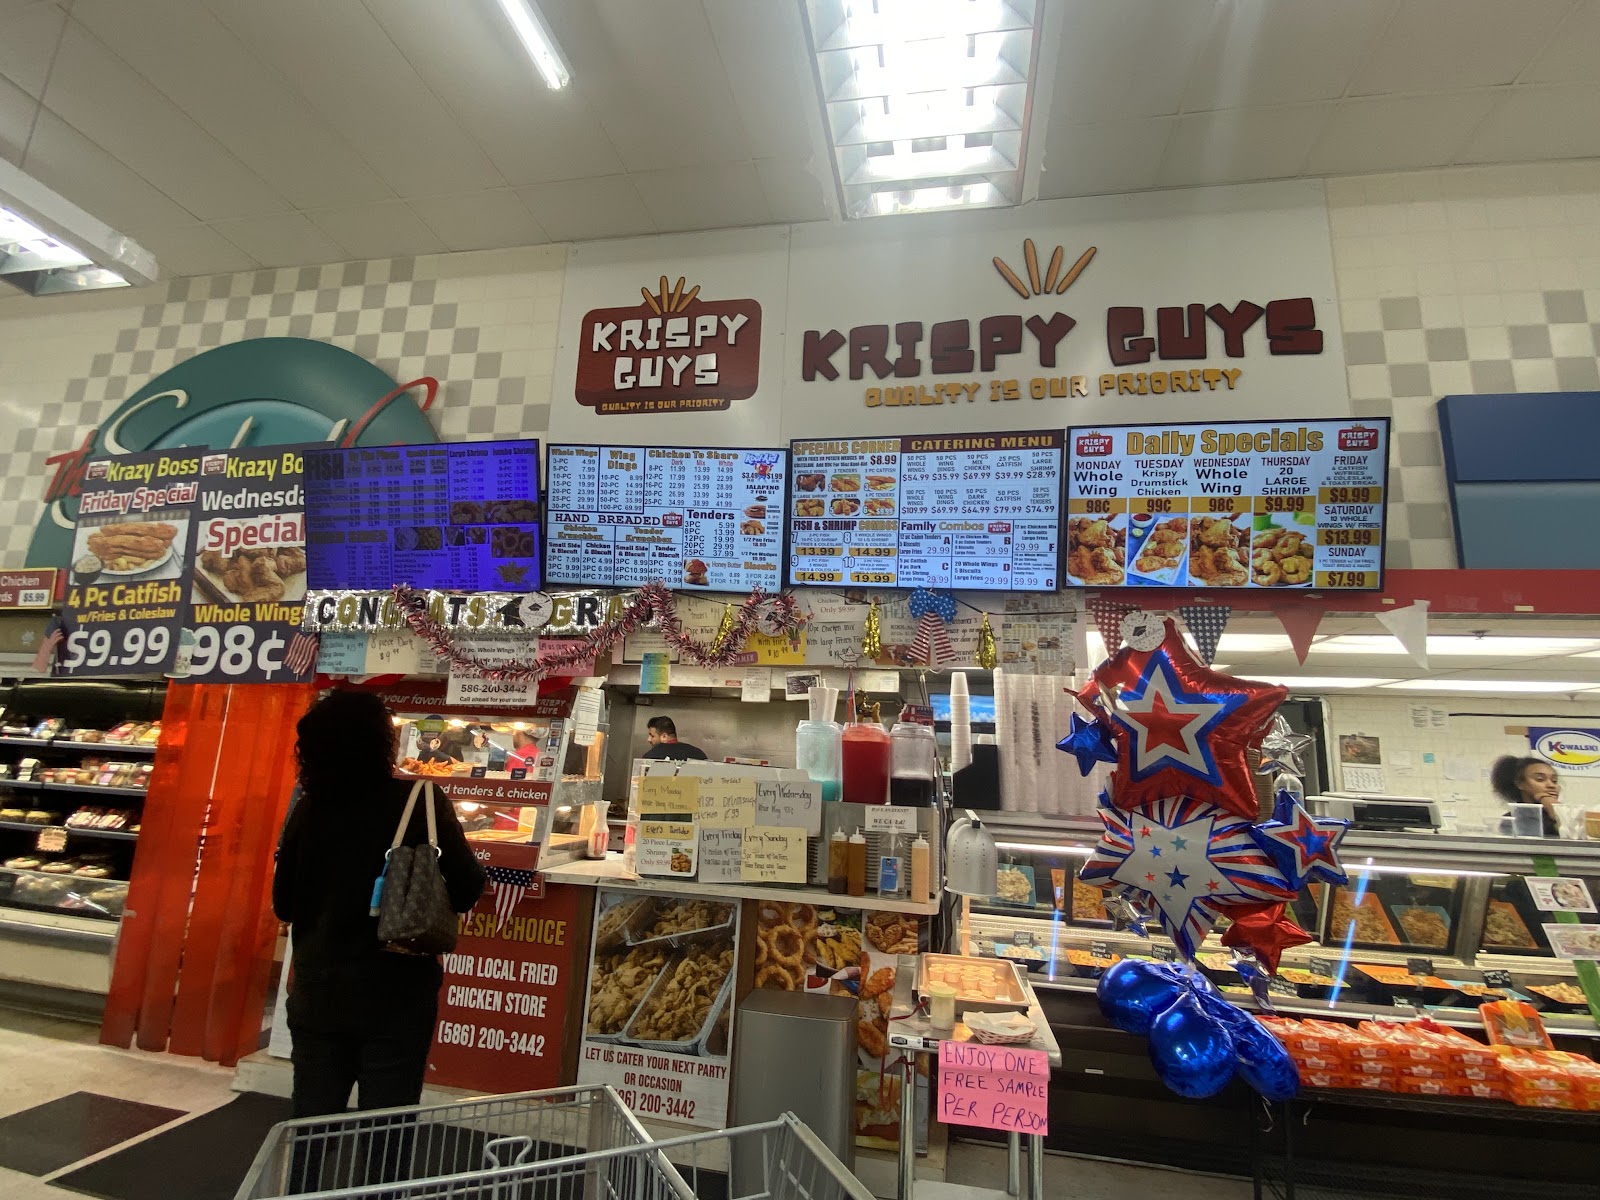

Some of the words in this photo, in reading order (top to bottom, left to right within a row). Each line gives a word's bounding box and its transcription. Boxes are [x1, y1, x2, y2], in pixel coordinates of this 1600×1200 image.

[593, 313, 748, 352] KRISPY
[802, 311, 1077, 382] KRISPY
[1107, 297, 1324, 366] GUYS
[614, 353, 718, 390] GUYS
[864, 381, 981, 408] QUALITY
[990, 378, 1021, 402] IS
[1030, 374, 1089, 399] OUR
[1099, 367, 1243, 396] PRIORITY
[602, 401, 641, 411] QUALITY
[644, 400, 655, 410] IS
[657, 400, 677, 409] OUR
[679, 398, 725, 408] PRIORITY
[793, 442, 848, 455] SPECIALS
[851, 440, 900, 453] CORNER
[911, 438, 996, 450] CATERING
[1001, 436, 1053, 448] MENU
[1079, 438, 1110, 446] KRISPY
[1127, 431, 1195, 456] Daily
[1201, 427, 1323, 456] Specials
[649, 450, 691, 458] Chicken
[692, 451, 705, 459] To
[706, 451, 739, 460] Share
[870, 455, 897, 465] $8.99
[1261, 457, 1310, 466] THURSDAY
[1334, 456, 1368, 465] FRIDAY
[226, 457, 277, 481] Krazy
[281, 453, 304, 475] Bo
[1076, 461, 1121, 470] MONDAY
[1135, 459, 1184, 468] TUESDAY
[1194, 458, 1250, 467] WEDNESDAY
[107, 462, 154, 483] Krazy
[157, 457, 199, 477] Boss
[932, 473, 960, 481] $35.99
[963, 472, 991, 480] $69.99
[995, 471, 1024, 480] $39.99
[1026, 471, 1056, 479] $28.99
[1074, 471, 1123, 481] Whole
[1142, 470, 1177, 478] Krispy
[1196, 468, 1247, 479] Whole
[1279, 467, 1293, 475] 20
[902, 474, 930, 482] $54.99
[1131, 479, 1188, 487] Drumstick
[1265, 477, 1307, 485] LARGE
[1079, 485, 1117, 497] Wing
[1137, 488, 1181, 496] Chicken
[1201, 482, 1242, 495] Wing
[1262, 487, 1310, 495] SHRIMP
[1330, 487, 1370, 503] $9.99
[79, 491, 132, 514] Friday
[133, 482, 198, 512] Special
[202, 484, 304, 511] Wednesd
[1265, 496, 1304, 512] $9.99
[1086, 499, 1110, 513] 98¢
[1146, 498, 1171, 513] 99¢
[1209, 498, 1234, 512] 98¢
[1324, 506, 1374, 514] SATURDAY
[555, 514, 590, 522] HAND
[598, 515, 661, 525] BREADED
[687, 509, 735, 520] Tenders
[793, 521, 812, 530] FISH
[814, 521, 821, 530] &
[822, 521, 857, 530] SHRIMP
[859, 521, 898, 530] COMBOS
[901, 522, 936, 532] Family
[939, 521, 984, 531] Combos
[208, 514, 305, 555] Special
[1325, 530, 1371, 545] $13.99
[1329, 548, 1366, 557] SUNDAY
[1, 575, 40, 587] Chicken
[1328, 571, 1365, 587] $7.99
[23, 592, 45, 602] $5.99
[68, 589, 80, 608] 4
[84, 588, 108, 608] Pc
[112, 580, 182, 606] Catfish
[76, 610, 115, 623] w/Fries
[118, 609, 126, 621] &
[129, 607, 176, 621] Coleslaw
[195, 603, 250, 623] Whole
[550, 597, 653, 626] GRA
[63, 624, 170, 674] $9.99
[190, 625, 285, 680] 98¢
[461, 684, 527, 694] 586-200-3442
[384, 693, 408, 704] your
[411, 694, 447, 706] favorit
[1548, 741, 1599, 755] KOWALSKI
[453, 785, 493, 796] tenders
[496, 787, 504, 797] &
[507, 788, 548, 800] chicken
[758, 783, 777, 804] Every
[702, 830, 720, 846] Every
[744, 828, 764, 849] Every
[764, 832, 788, 851] Sunday
[646, 849, 667, 857] Shrimp
[641, 859, 655, 867] Only
[457, 912, 497, 938] ESH
[502, 914, 567, 946] CHOICE
[442, 952, 475, 976] YOUR
[477, 957, 517, 982] LOCAL
[520, 962, 558, 986] FRIED
[447, 985, 503, 1012] CHICKEN
[505, 992, 547, 1018] STORE
[438, 1020, 476, 1048] (586)
[478, 1026, 545, 1057] 200-3442
[585, 1047, 601, 1060] LET
[603, 1051, 614, 1063] US
[617, 1052, 644, 1068] CATER
[647, 1056, 669, 1071] YOUR
[672, 1060, 696, 1075] NEXT
[698, 1063, 727, 1080] PARTY
[945, 1042, 996, 1072] ENJOY
[1005, 1052, 1041, 1076] ONE
[624, 1072, 636, 1086] OR
[638, 1074, 682, 1093] OCCASION
[944, 1072, 988, 1090] FREE
[998, 1077, 1046, 1098] SAMPLE
[639, 1092, 696, 1119] 200-3442
[944, 1093, 978, 1118] PER
[991, 1102, 1048, 1131] PERSON
